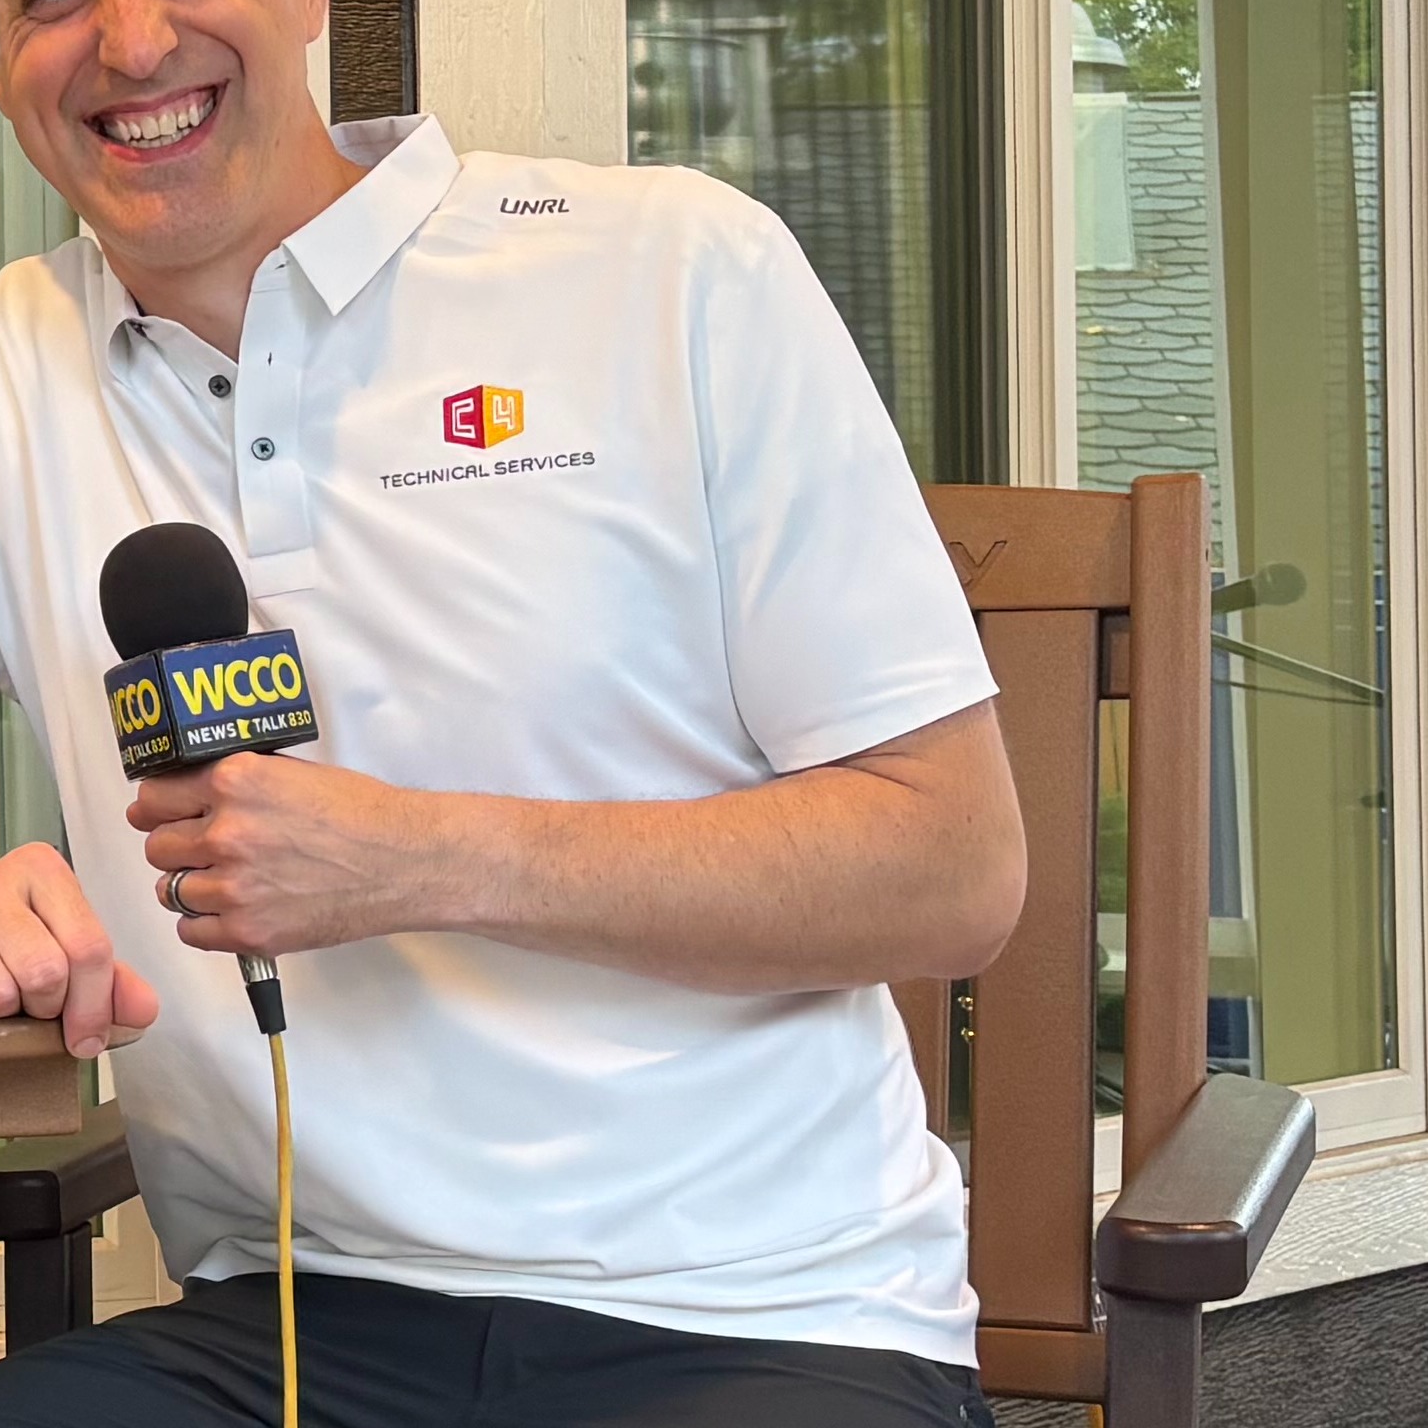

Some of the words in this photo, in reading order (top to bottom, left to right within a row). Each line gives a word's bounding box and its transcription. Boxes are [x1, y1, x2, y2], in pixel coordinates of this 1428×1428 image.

[499, 197, 570, 215] UNRL
[380, 464, 490, 490] TECHNICAL
[493, 451, 595, 475] SERVICES
[172, 652, 302, 716] WCCO
[186, 723, 238, 746] NEWS
[251, 714, 288, 734] TALK
[288, 709, 312, 728] 830
